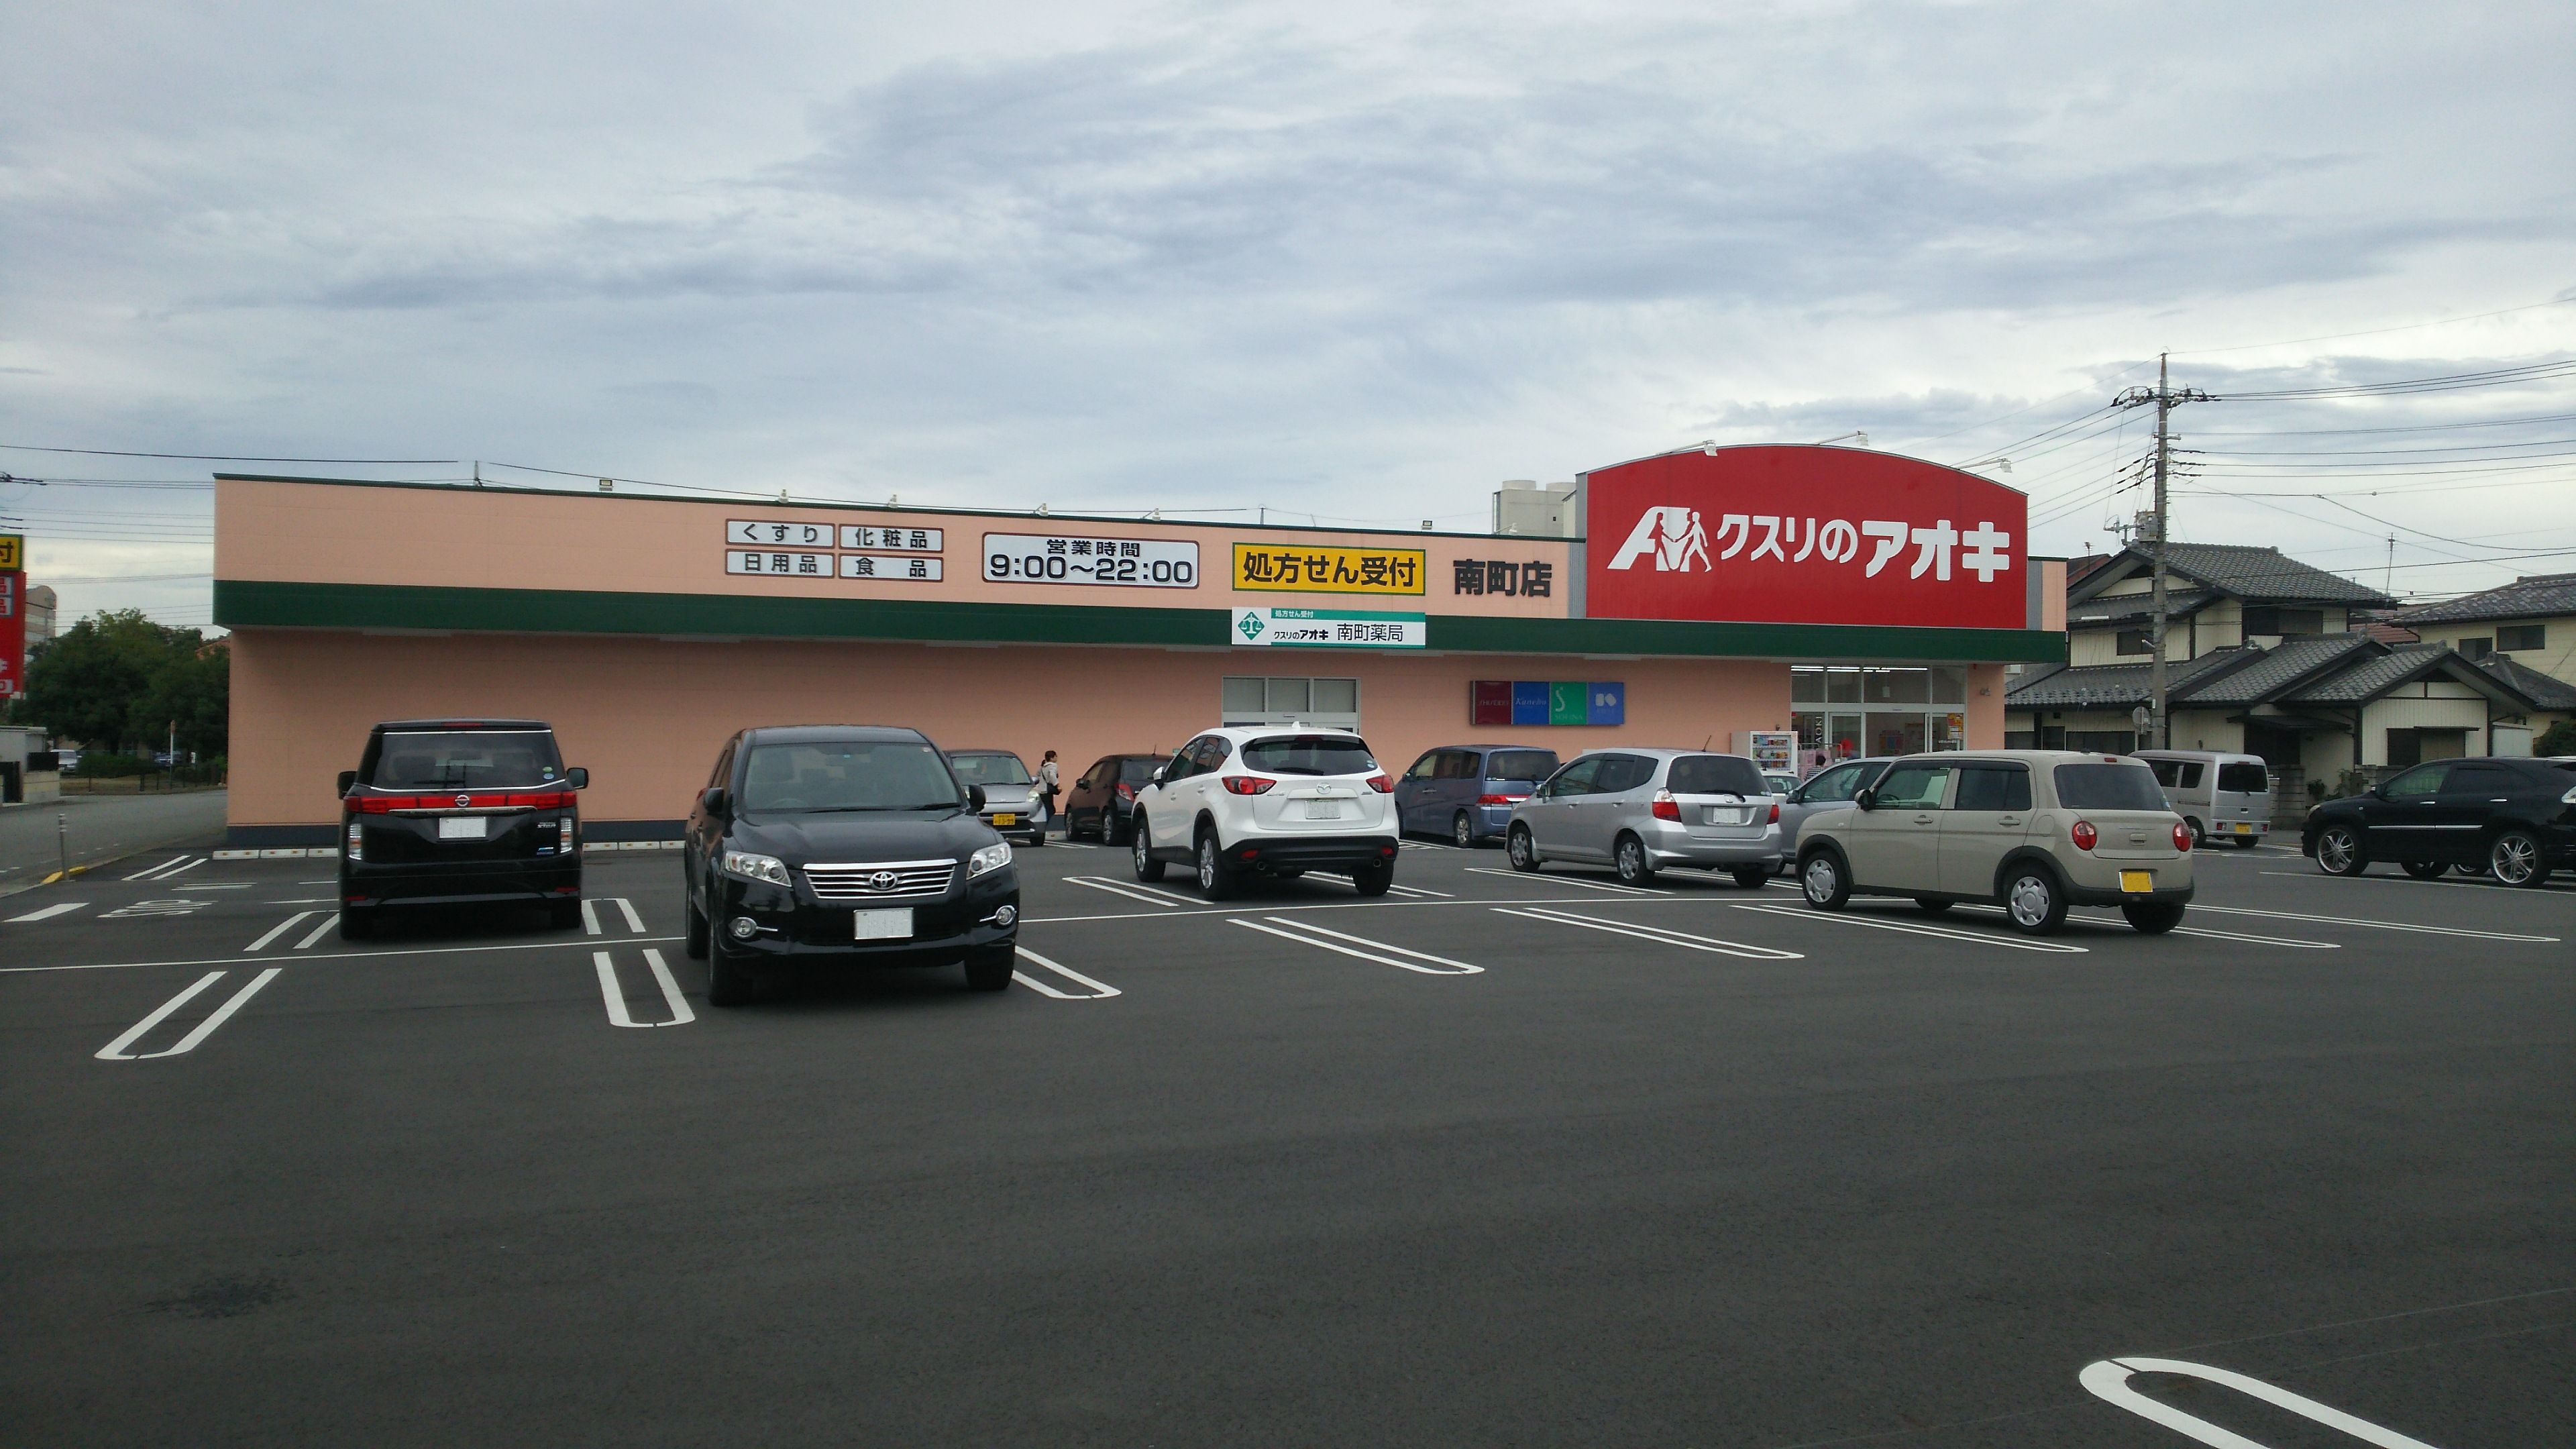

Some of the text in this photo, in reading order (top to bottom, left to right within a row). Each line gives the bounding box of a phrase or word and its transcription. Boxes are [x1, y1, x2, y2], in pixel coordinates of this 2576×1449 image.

[743, 524, 818, 543] くすり
[855, 527, 927, 549] 化粧品
[1046, 539, 1140, 557] 営業時間
[1717, 513, 2010, 582] クスリのアオキ
[745, 553, 817, 574] 日用品
[1243, 551, 1416, 588] 処方せん受付
[1453, 558, 1552, 597] 南町店
[1275, 610, 1314, 619] 処方せん受付
[1274, 623, 1403, 641] クスリのアオキ 南町薬局
